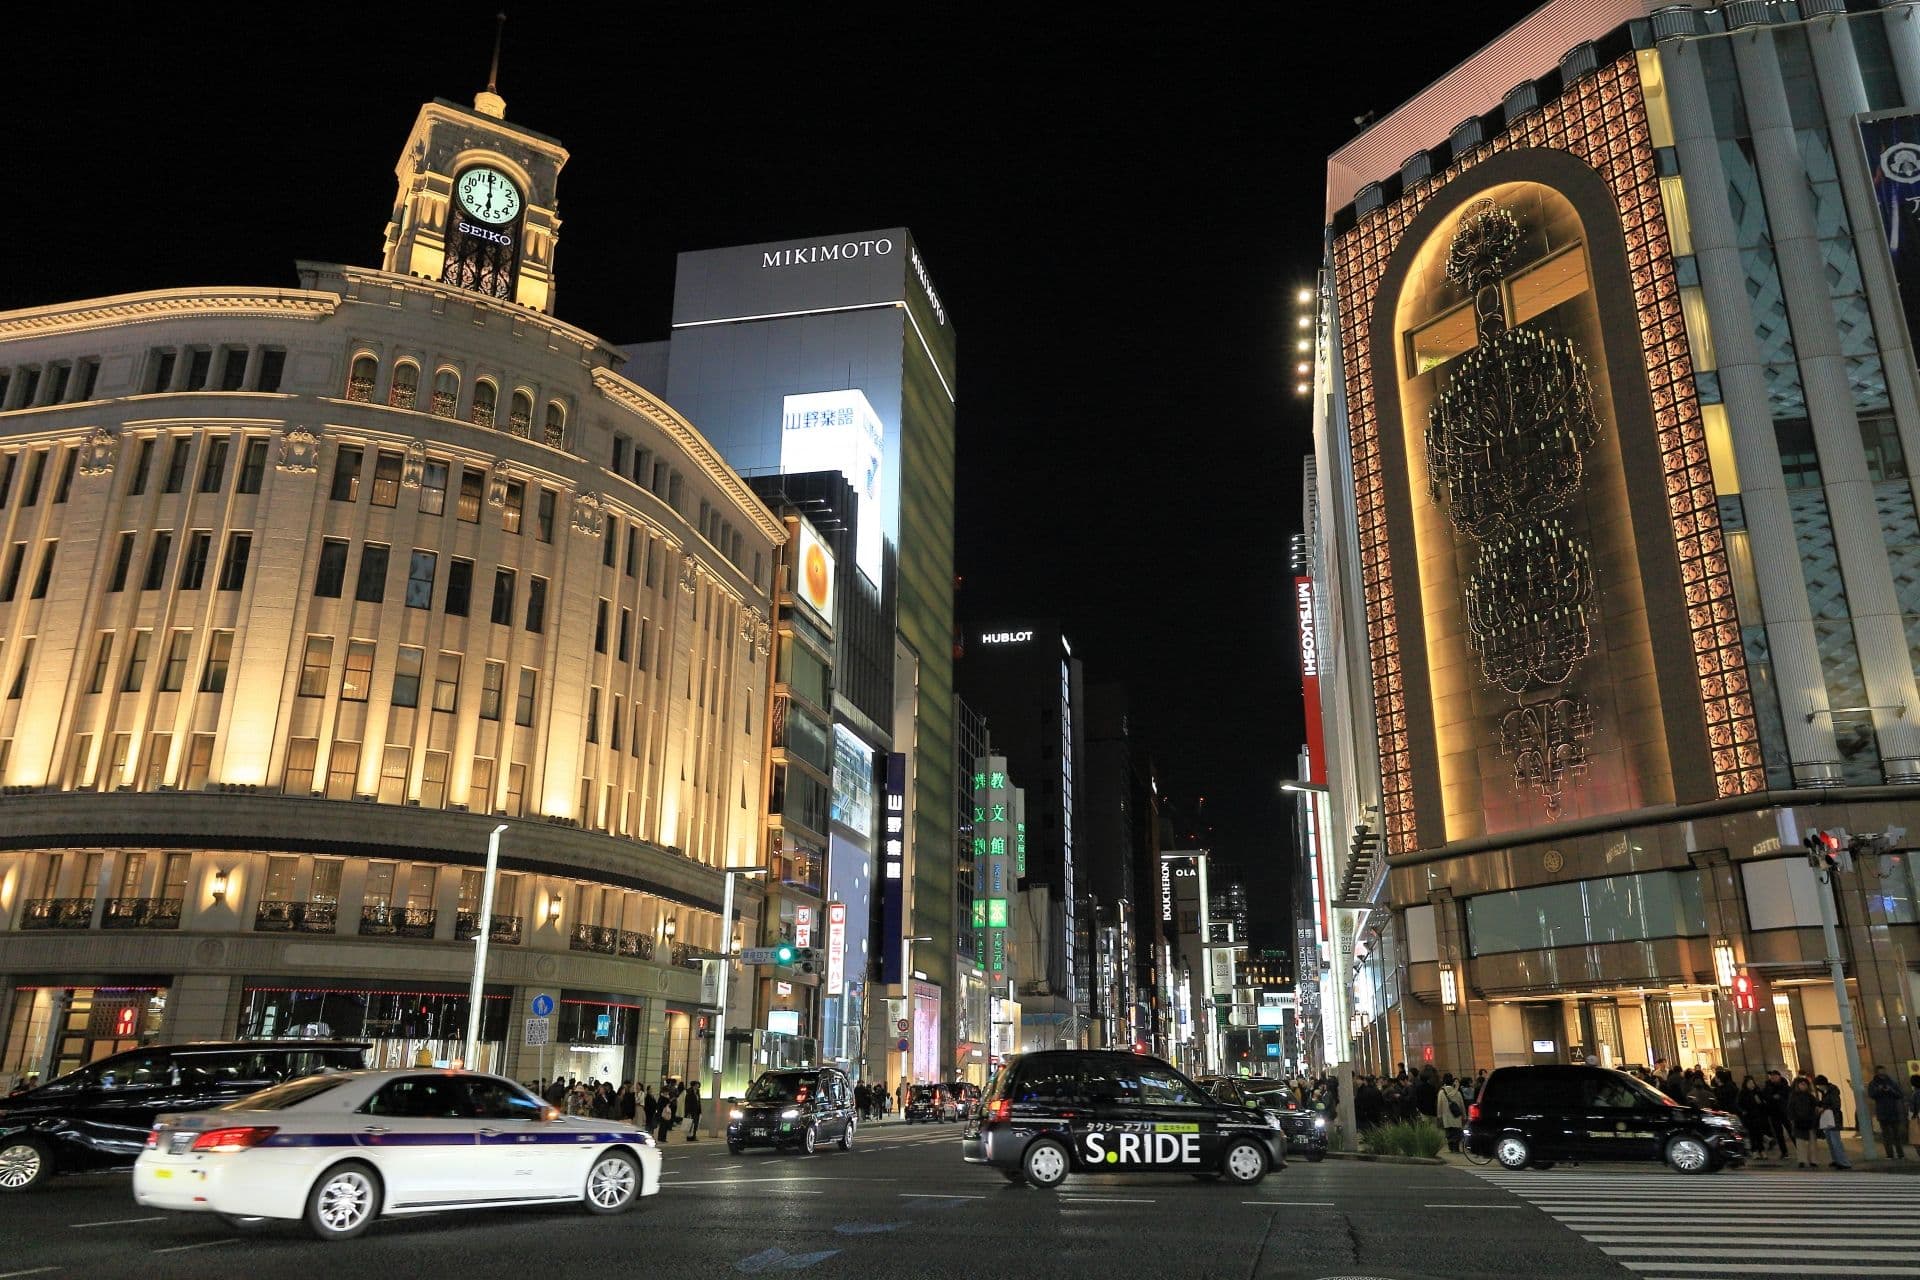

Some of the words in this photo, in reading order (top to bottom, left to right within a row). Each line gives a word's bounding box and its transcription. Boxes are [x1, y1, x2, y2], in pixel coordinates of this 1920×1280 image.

[468, 177, 477, 187] 10
[464, 185, 472, 193] 9
[505, 189, 512, 198] 2
[466, 195, 474, 204] 8
[507, 199, 514, 208] 3
[475, 203, 482, 212] 7
[502, 207, 510, 215] 4
[483, 209, 490, 218] 6
[493, 210, 500, 219] 5
[459, 222, 511, 246] SEIKO
[762, 239, 892, 268] MIKIMOTO
[912, 247, 944, 326] MIKIMOTO
[785, 407, 853, 430] 山野楽器
[1298, 583, 1317, 676] MITSUKOSHI
[982, 631, 1033, 644] HUBLOT
[990, 770, 1005, 856] 教文館
[1175, 868, 1196, 877] OLA
[1161, 862, 1171, 921] BOUCHERON
[1086, 1122, 1152, 1132] タクシーアプリ
[1086, 1133, 1200, 1163] S.RIDE
